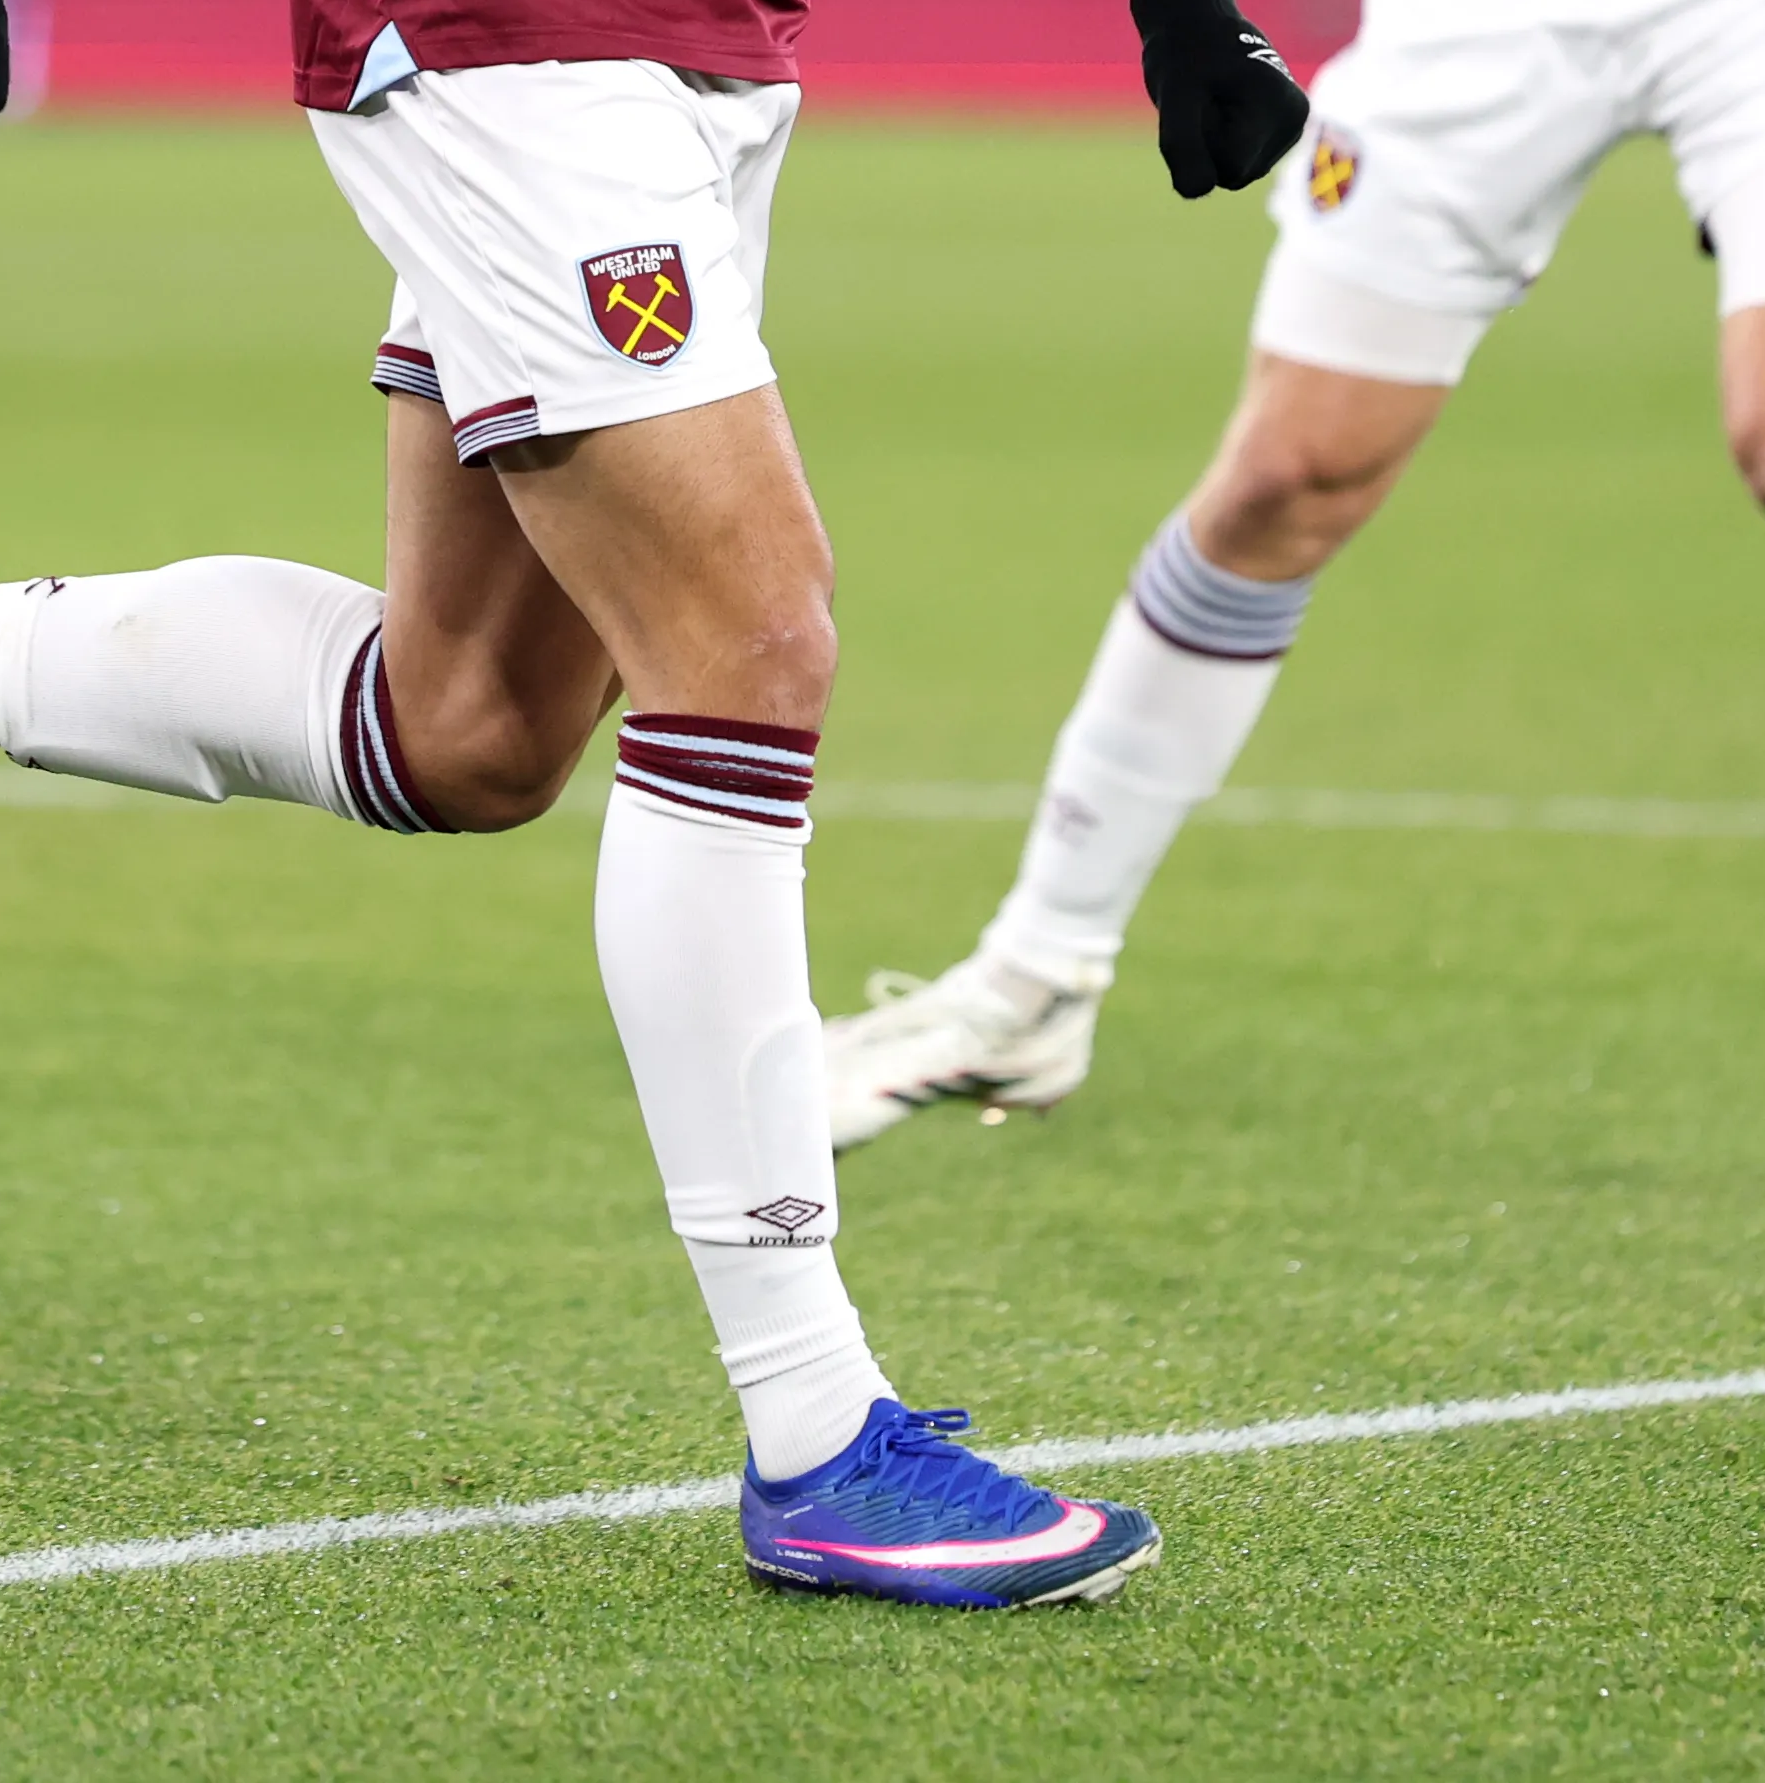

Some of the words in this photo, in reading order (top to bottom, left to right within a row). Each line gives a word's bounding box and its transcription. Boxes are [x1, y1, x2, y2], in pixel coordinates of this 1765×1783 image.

[588, 251, 634, 276] WEST
[636, 246, 675, 264] HAM
[610, 260, 661, 281] UNITED
[637, 344, 677, 361] LONDON
[749, 1234, 825, 1247] umbro
